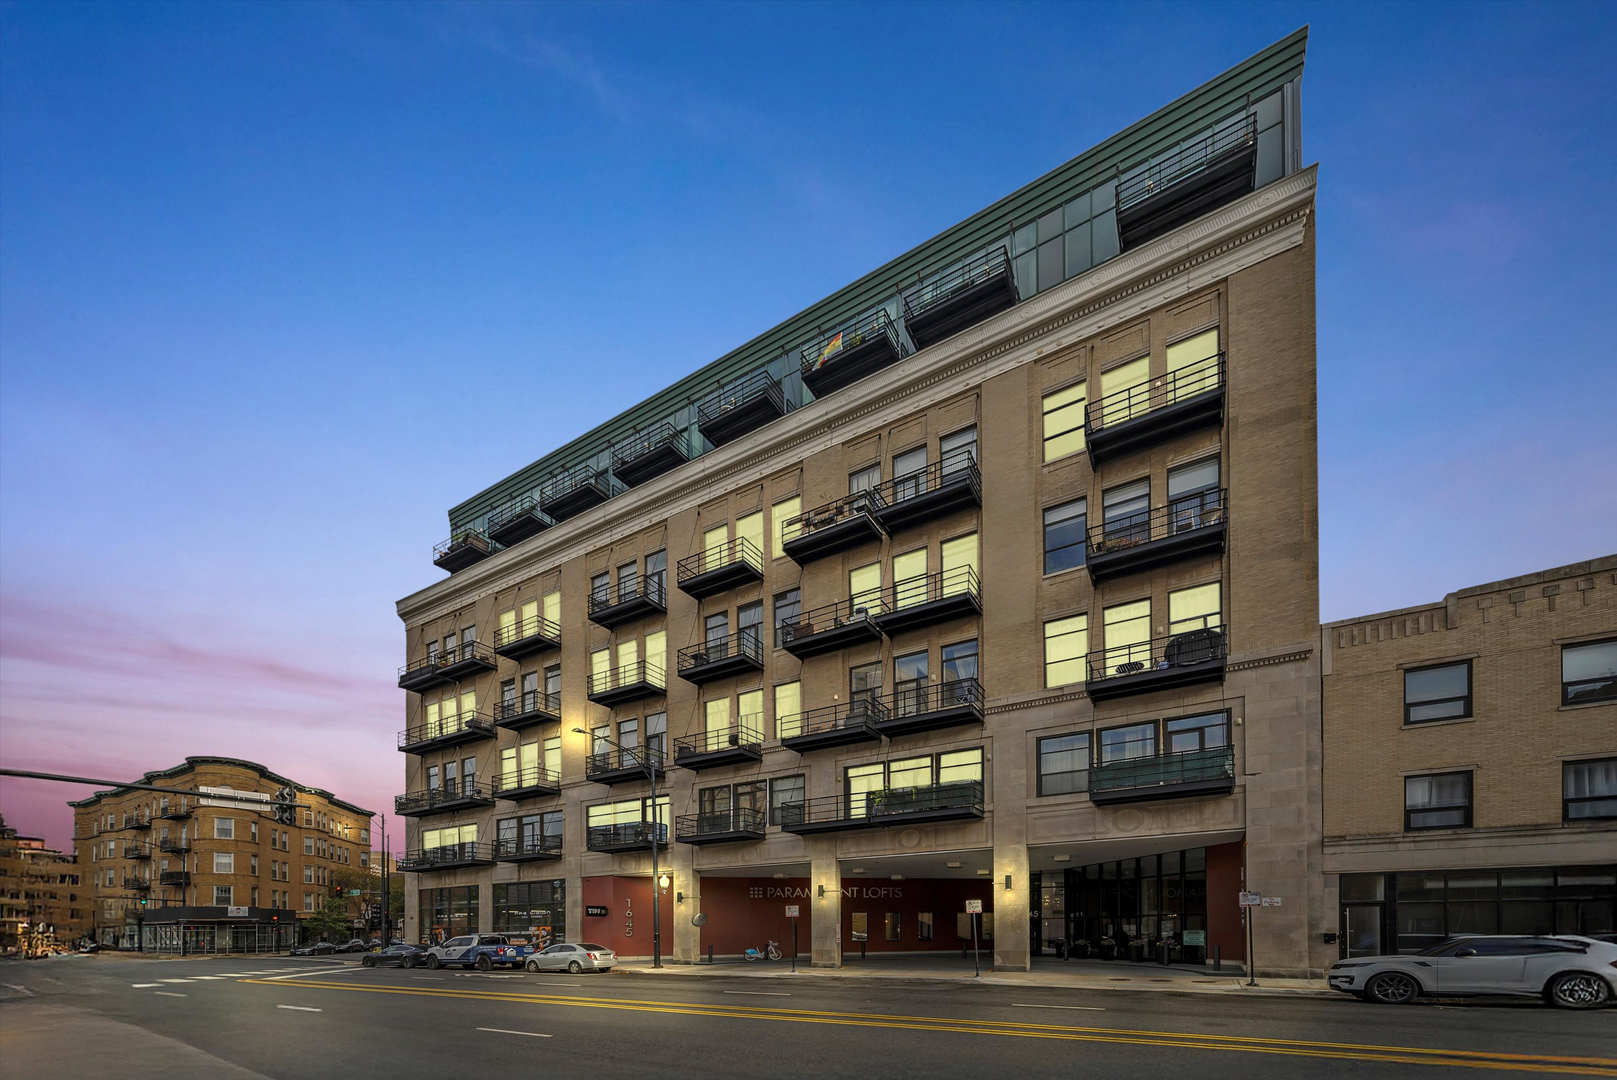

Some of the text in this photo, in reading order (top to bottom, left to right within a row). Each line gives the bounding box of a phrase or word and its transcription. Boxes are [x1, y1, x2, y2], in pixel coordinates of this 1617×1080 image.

[767, 887, 903, 898] PARAMNT LOFTS
[625, 898, 633, 937] 1645
